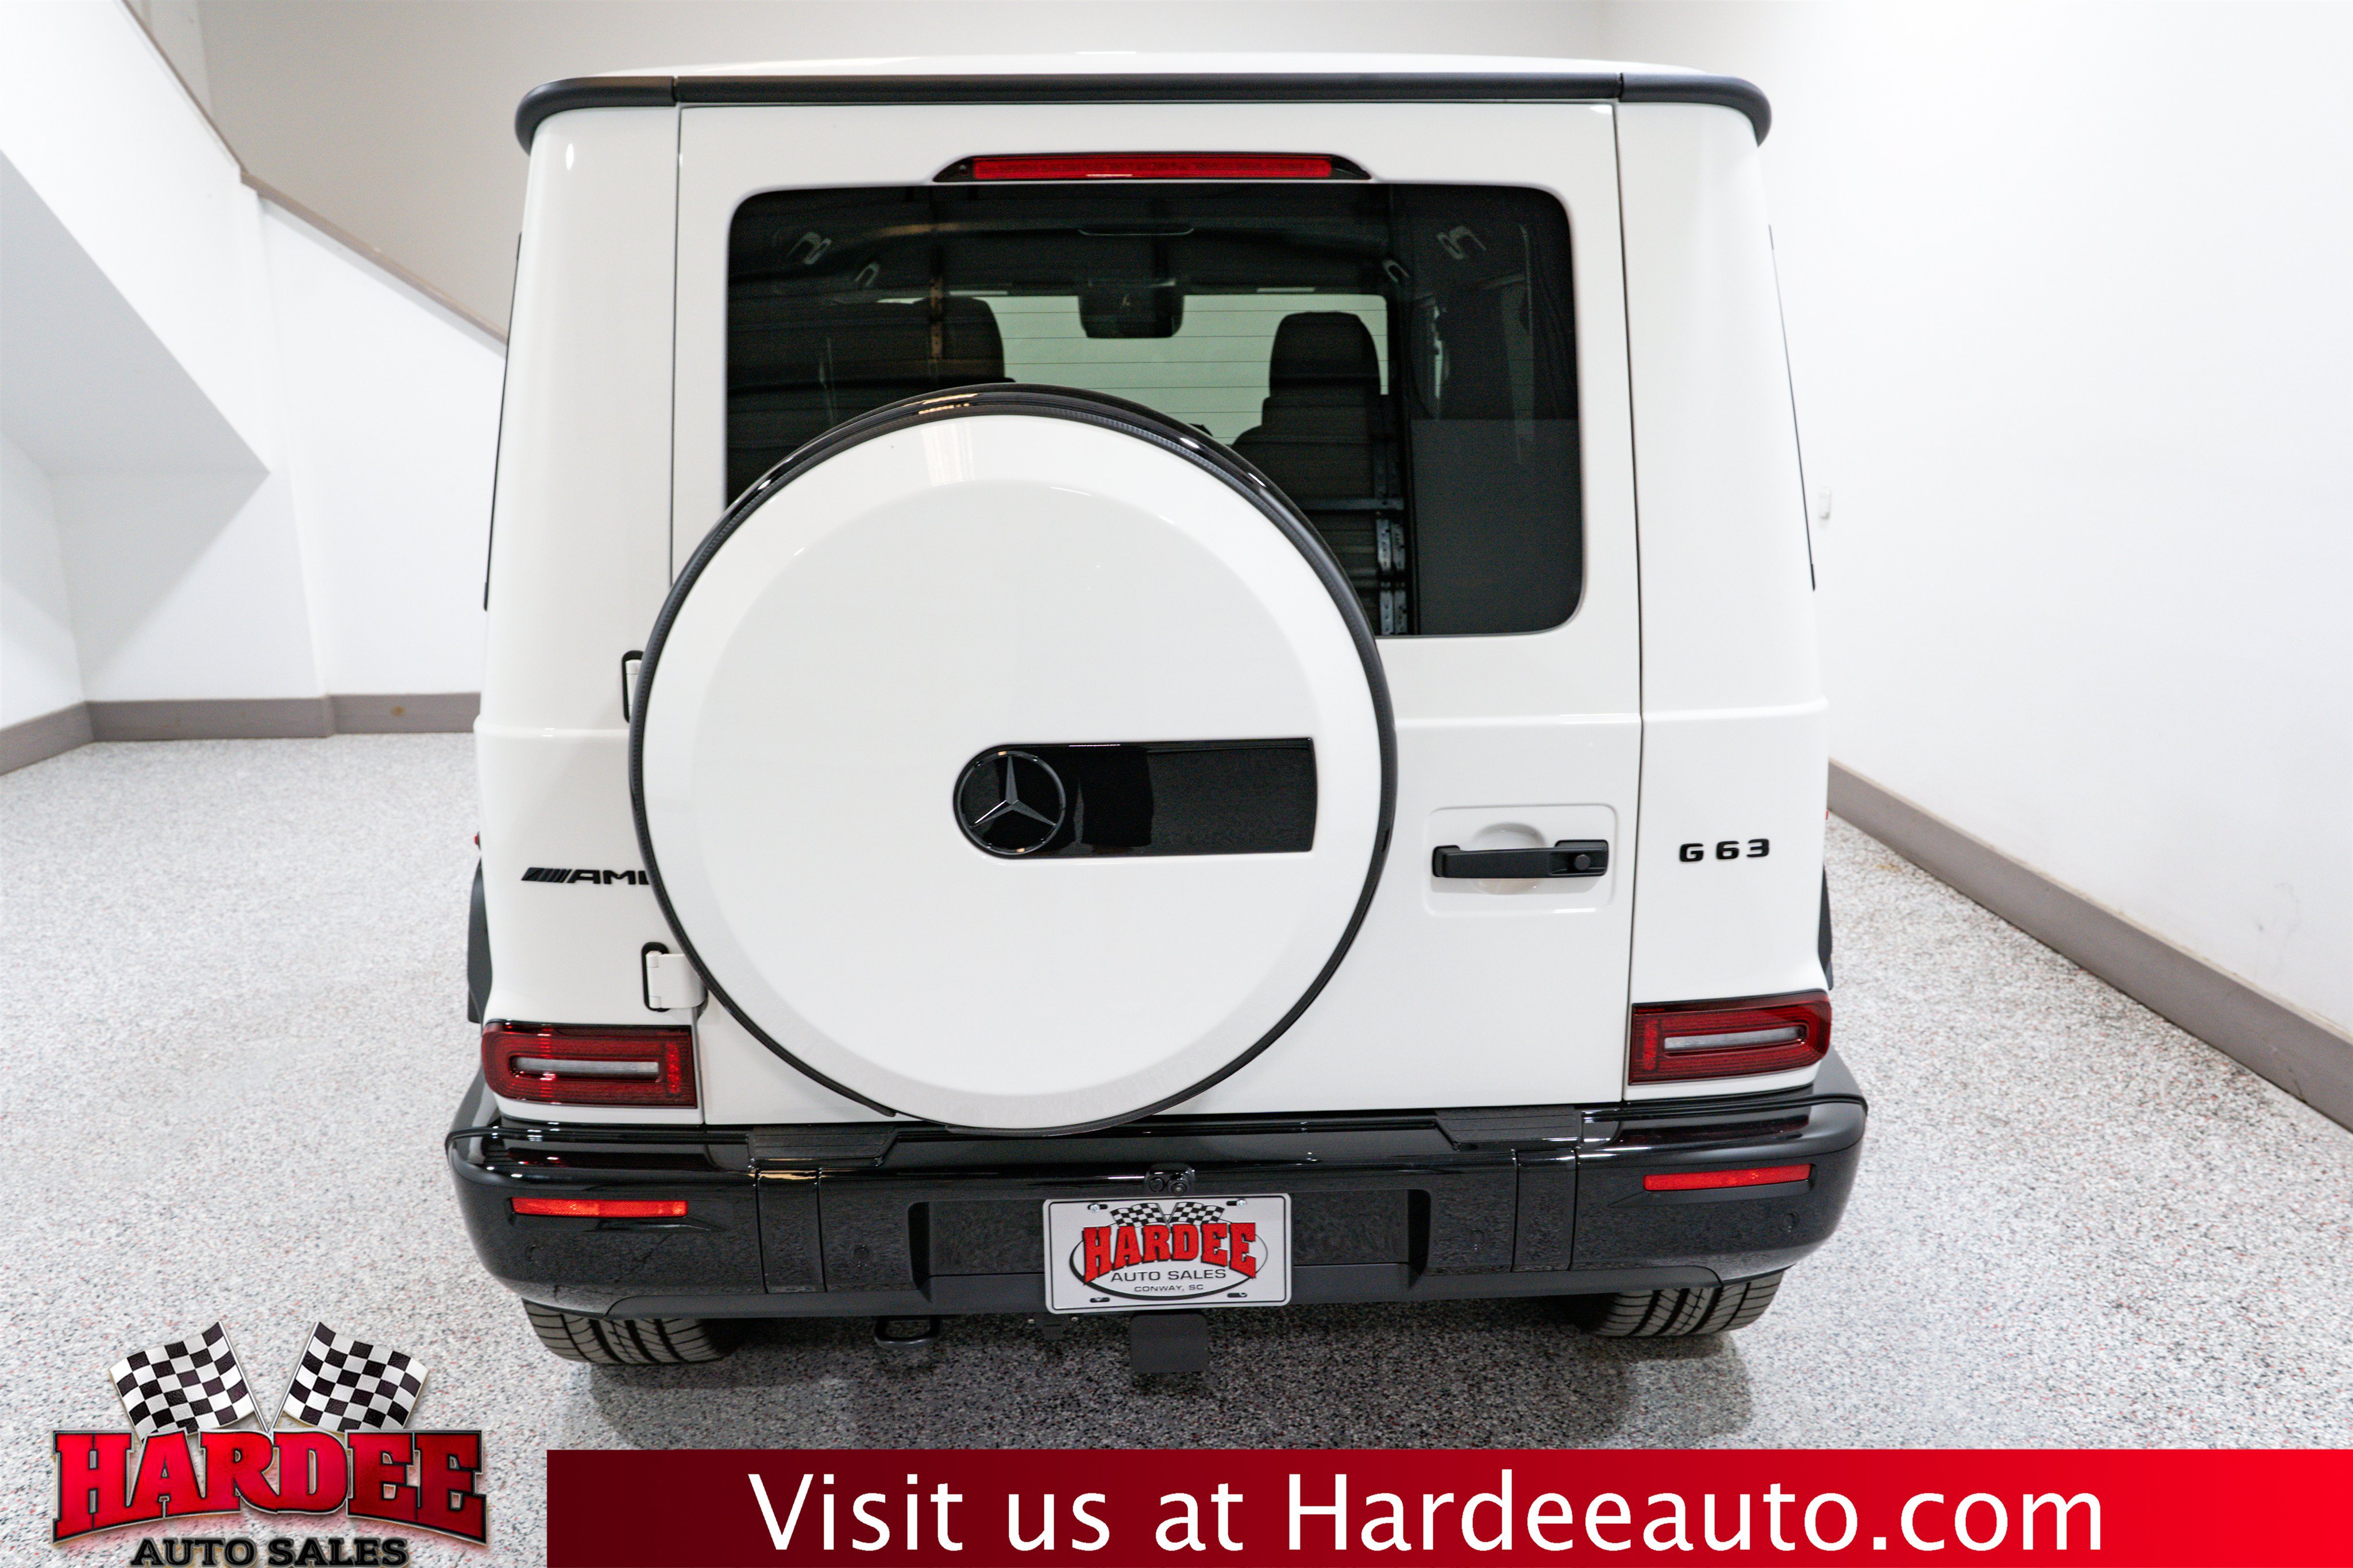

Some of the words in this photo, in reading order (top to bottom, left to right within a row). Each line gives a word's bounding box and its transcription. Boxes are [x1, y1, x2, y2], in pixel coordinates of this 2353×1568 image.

[1082, 1222, 1257, 1284] HARDEE
[1111, 1270, 1160, 1282] AUTO
[1168, 1269, 1227, 1281] SALES
